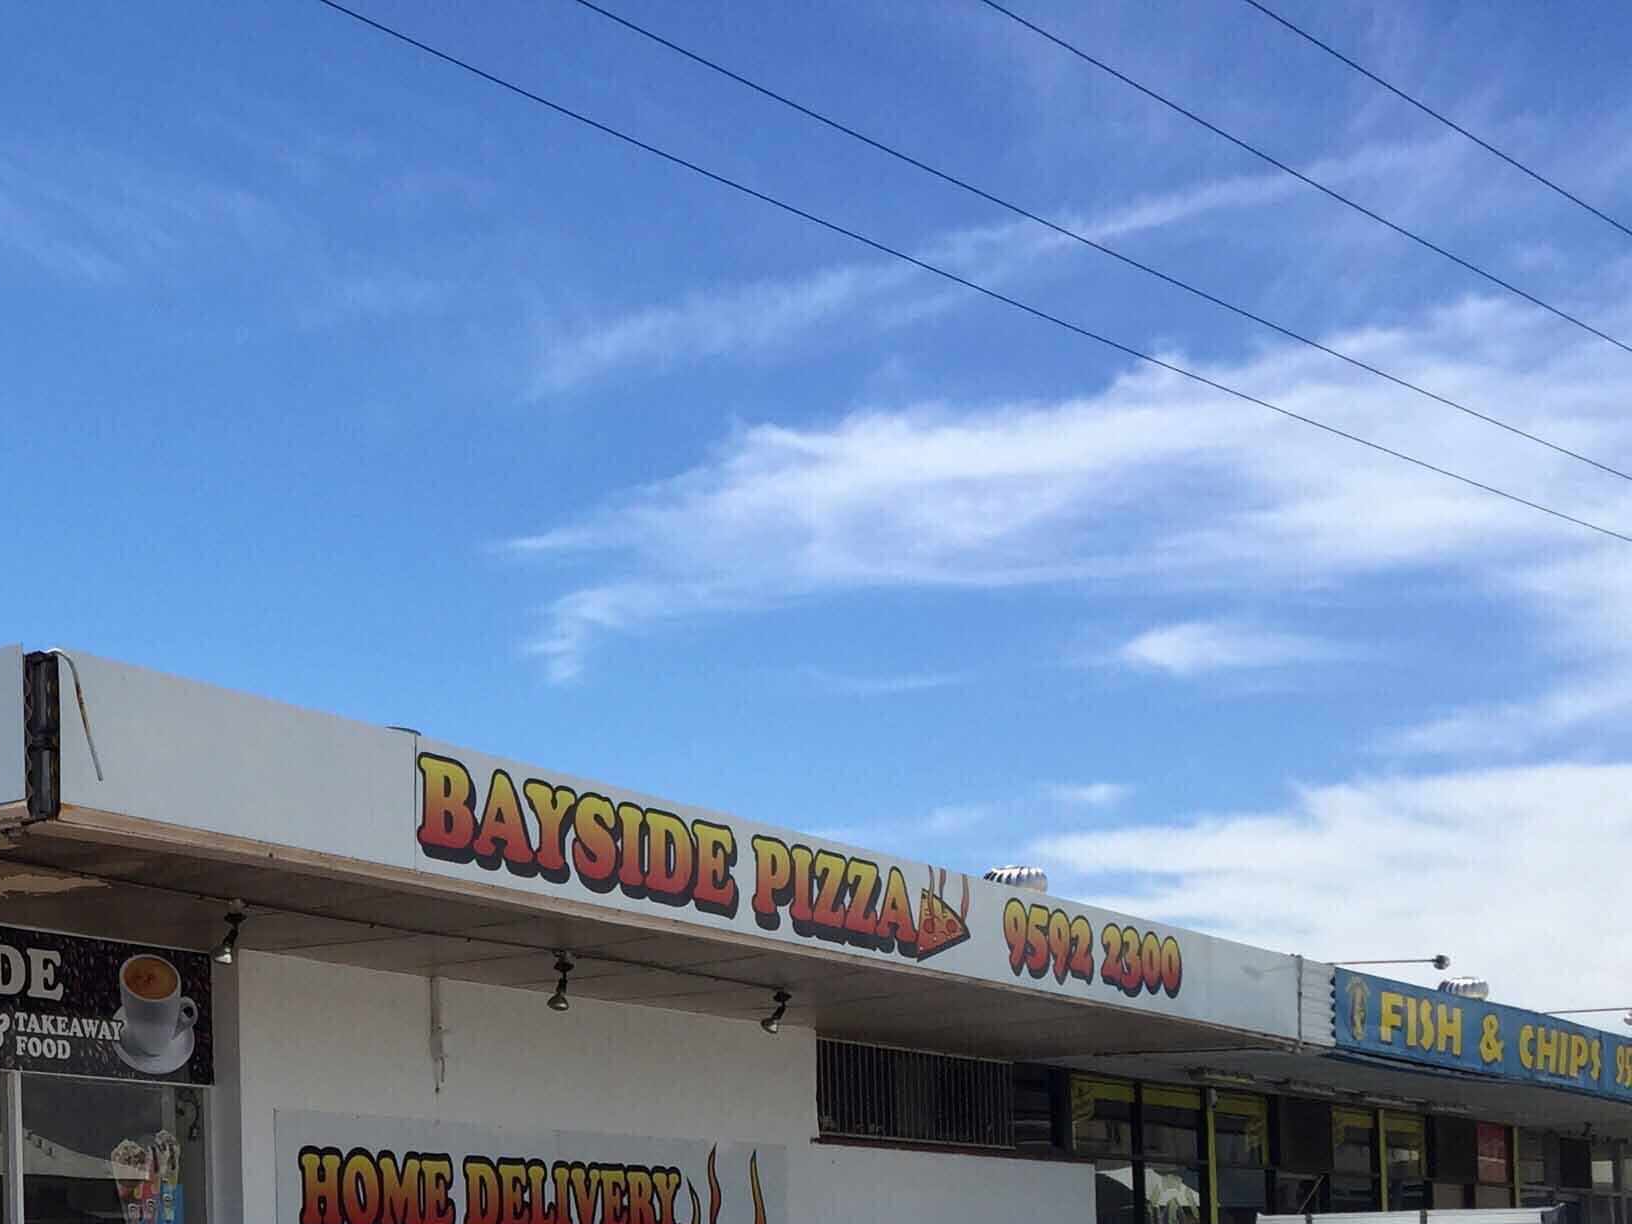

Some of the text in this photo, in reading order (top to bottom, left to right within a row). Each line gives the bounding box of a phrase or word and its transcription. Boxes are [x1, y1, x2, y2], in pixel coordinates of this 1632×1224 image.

[417, 752, 920, 955] BAYSIDE PIZZA
[1002, 897, 1182, 999] 9592 2300
[15, 1011, 128, 1041] TAKEAWAY
[16, 1035, 71, 1060] FOOD
[1380, 990, 1463, 1057] FISH
[1478, 1013, 1505, 1064] &
[1519, 1023, 1602, 1081] CHIPS
